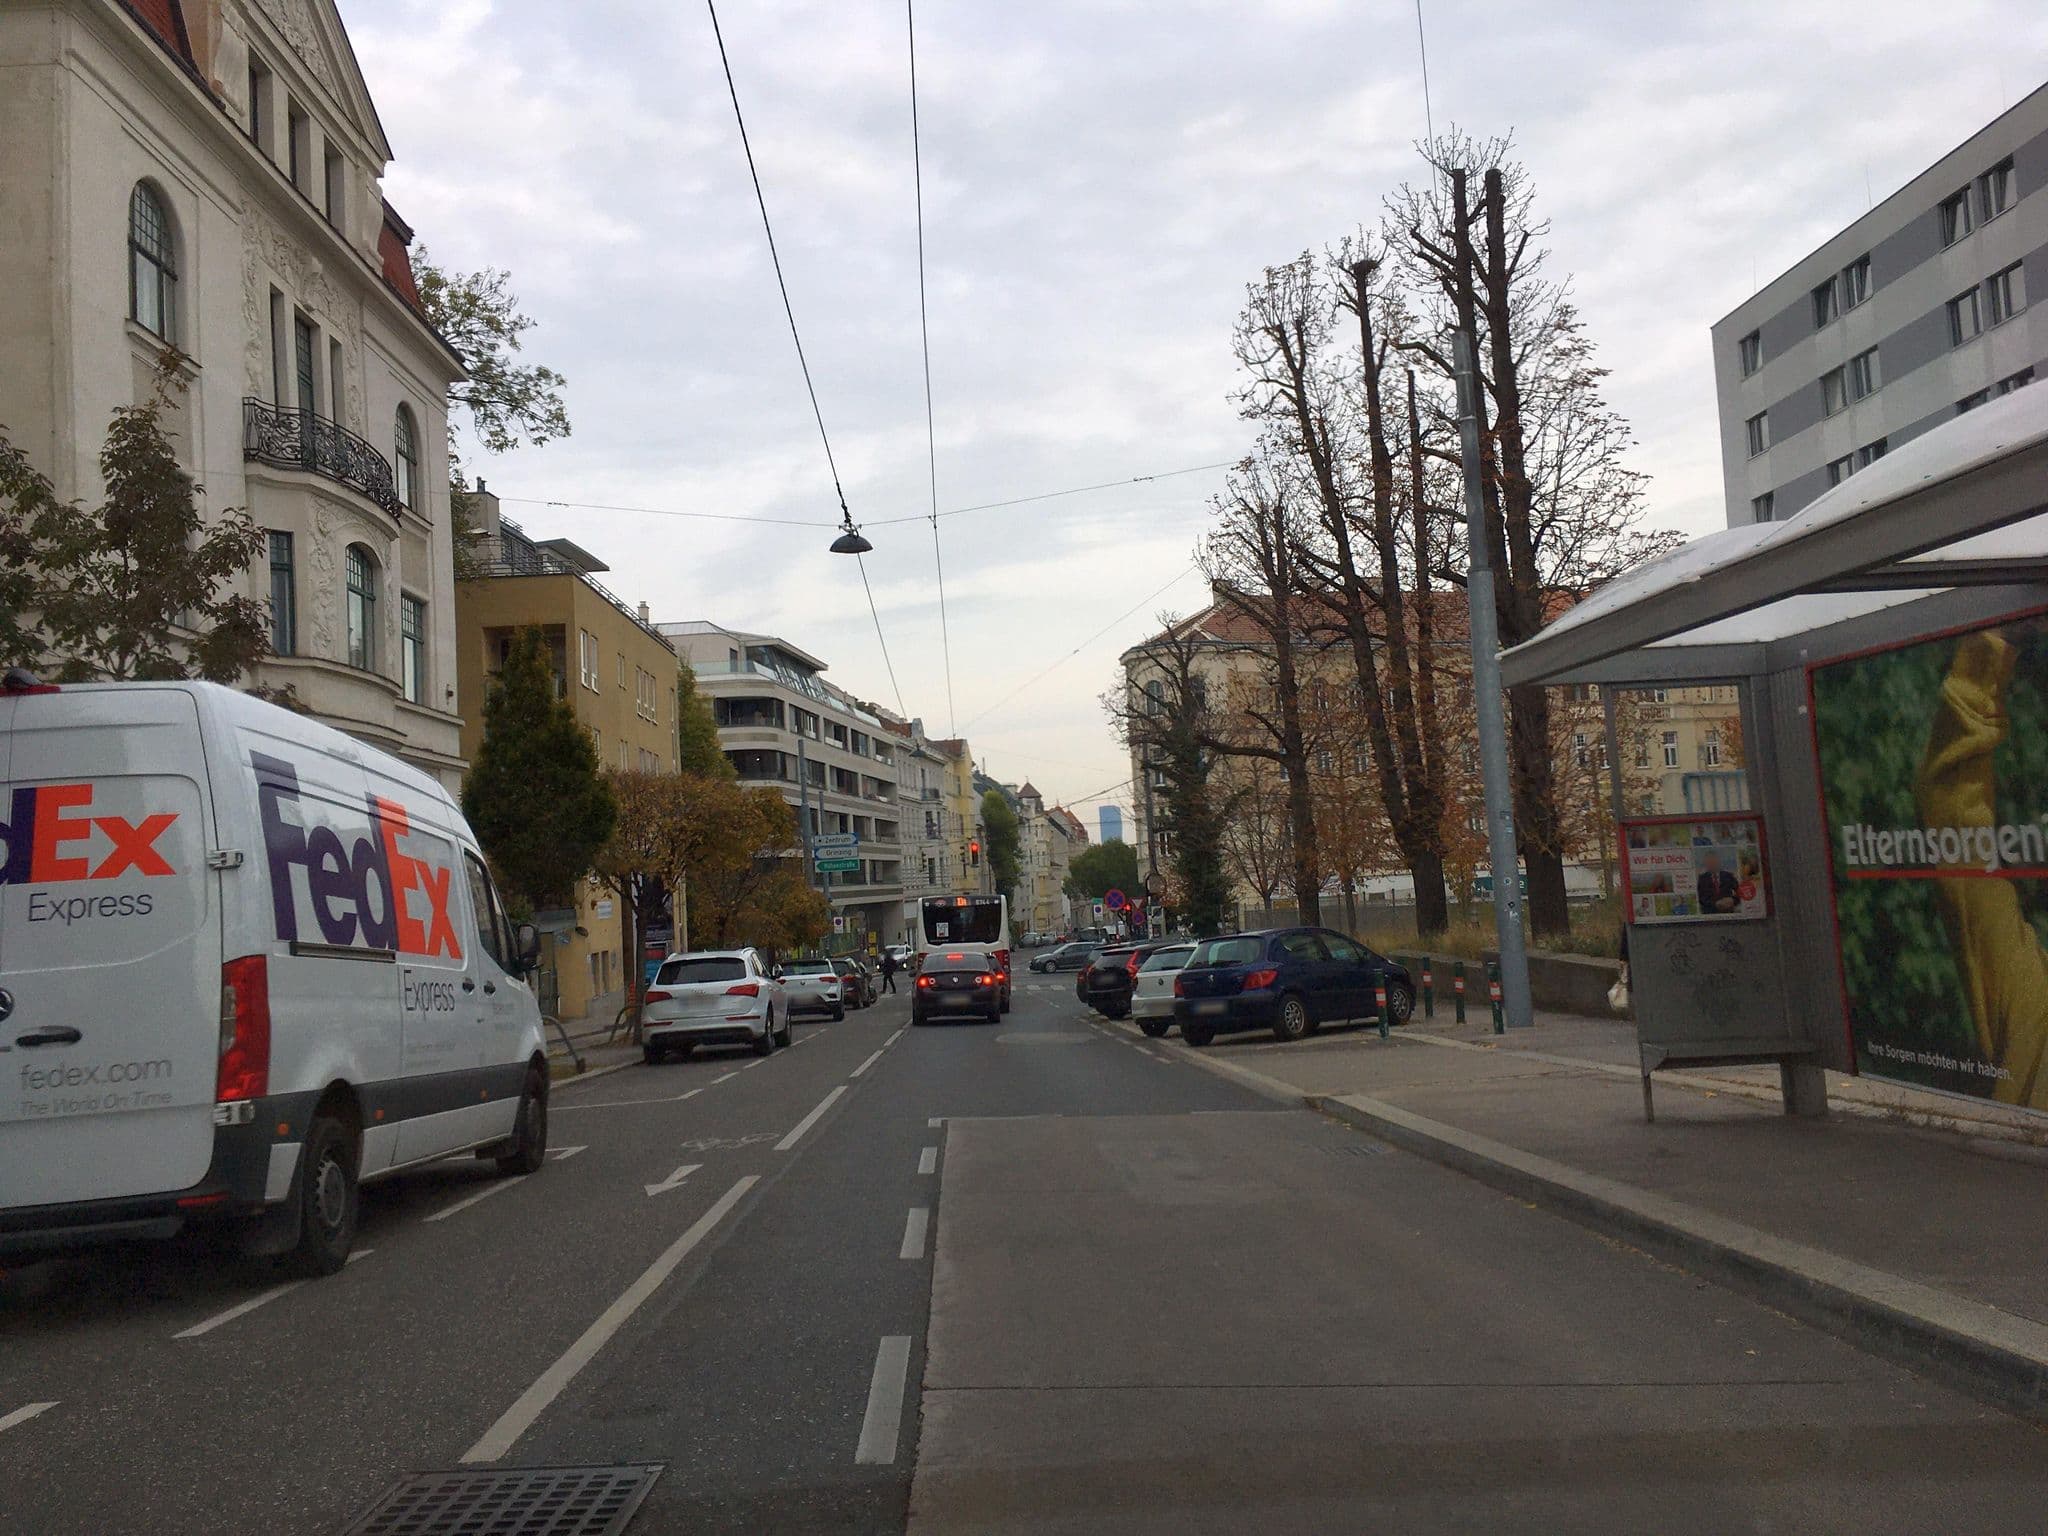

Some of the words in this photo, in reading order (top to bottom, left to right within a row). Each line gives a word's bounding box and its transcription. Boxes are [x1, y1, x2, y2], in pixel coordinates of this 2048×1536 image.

[250, 749, 463, 960] FedEx
[1633, 855, 1648, 865] Wir
[1842, 813, 2048, 873] Elternsorgen
[29, 892, 152, 926] Express
[403, 969, 456, 1022] Express
[21, 1058, 173, 1090] fedex.com
[1867, 1040, 1884, 1056] Ihre
[1886, 1043, 1917, 1063] Sorgen
[1918, 1051, 1958, 1070] möchten
[1960, 1058, 1975, 1074] wir
[1978, 1060, 2014, 1081] haben.
[21, 1100, 48, 1116] The
[53, 1094, 98, 1114] World
[103, 1092, 130, 1110] On
[133, 1090, 173, 1106] Time
